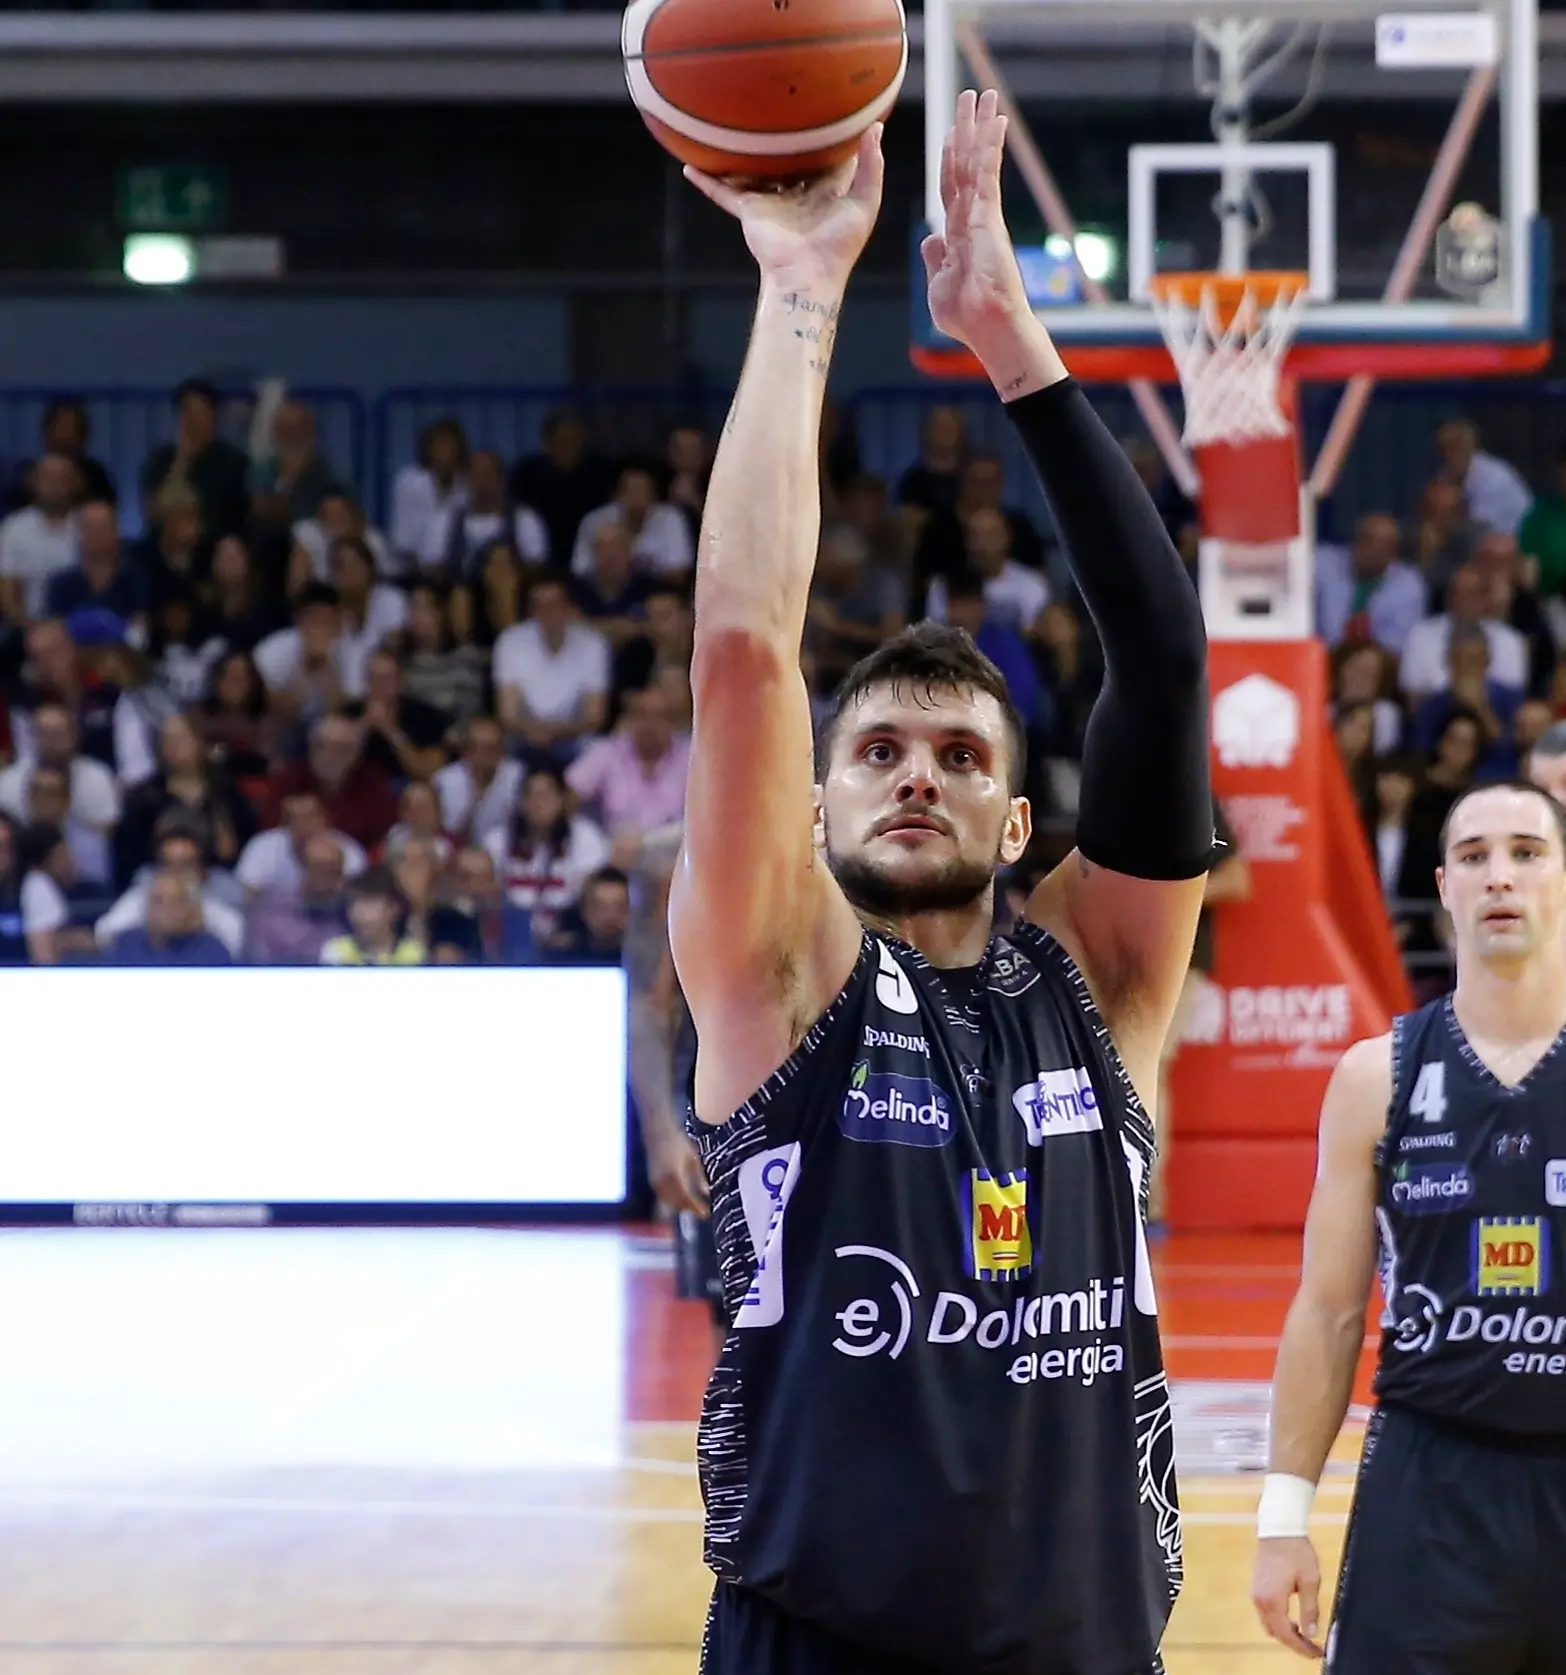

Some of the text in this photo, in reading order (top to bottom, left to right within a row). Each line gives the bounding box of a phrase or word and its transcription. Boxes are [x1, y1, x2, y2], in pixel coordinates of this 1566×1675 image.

[1024, 1087, 1098, 1129] TNTIO
[1409, 1062, 1449, 1123] 4
[1484, 1241, 1535, 1267] MD
